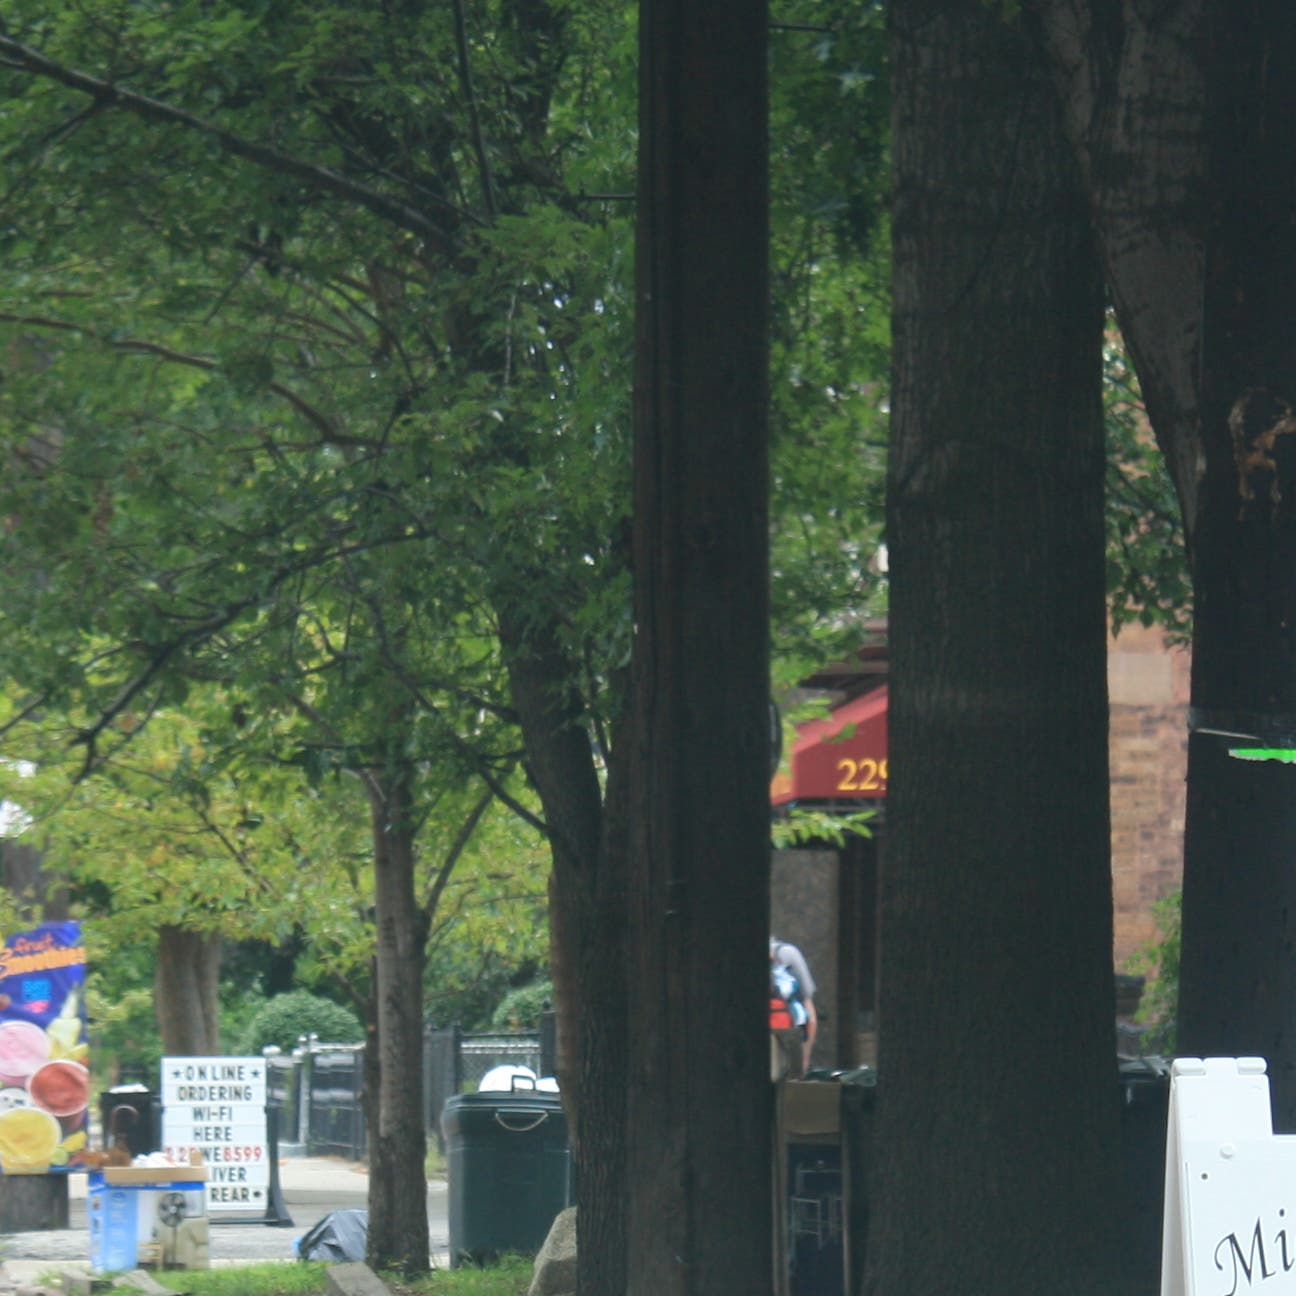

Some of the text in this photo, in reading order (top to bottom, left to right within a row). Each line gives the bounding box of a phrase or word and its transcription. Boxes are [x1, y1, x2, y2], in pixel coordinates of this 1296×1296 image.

[185, 1065, 245, 1081] ONLINE
[178, 1086, 252, 1101] ORDERING
[192, 1106, 233, 1121] WI-FI
[193, 1126, 233, 1141] HERE
[210, 1187, 250, 1202] REAR
